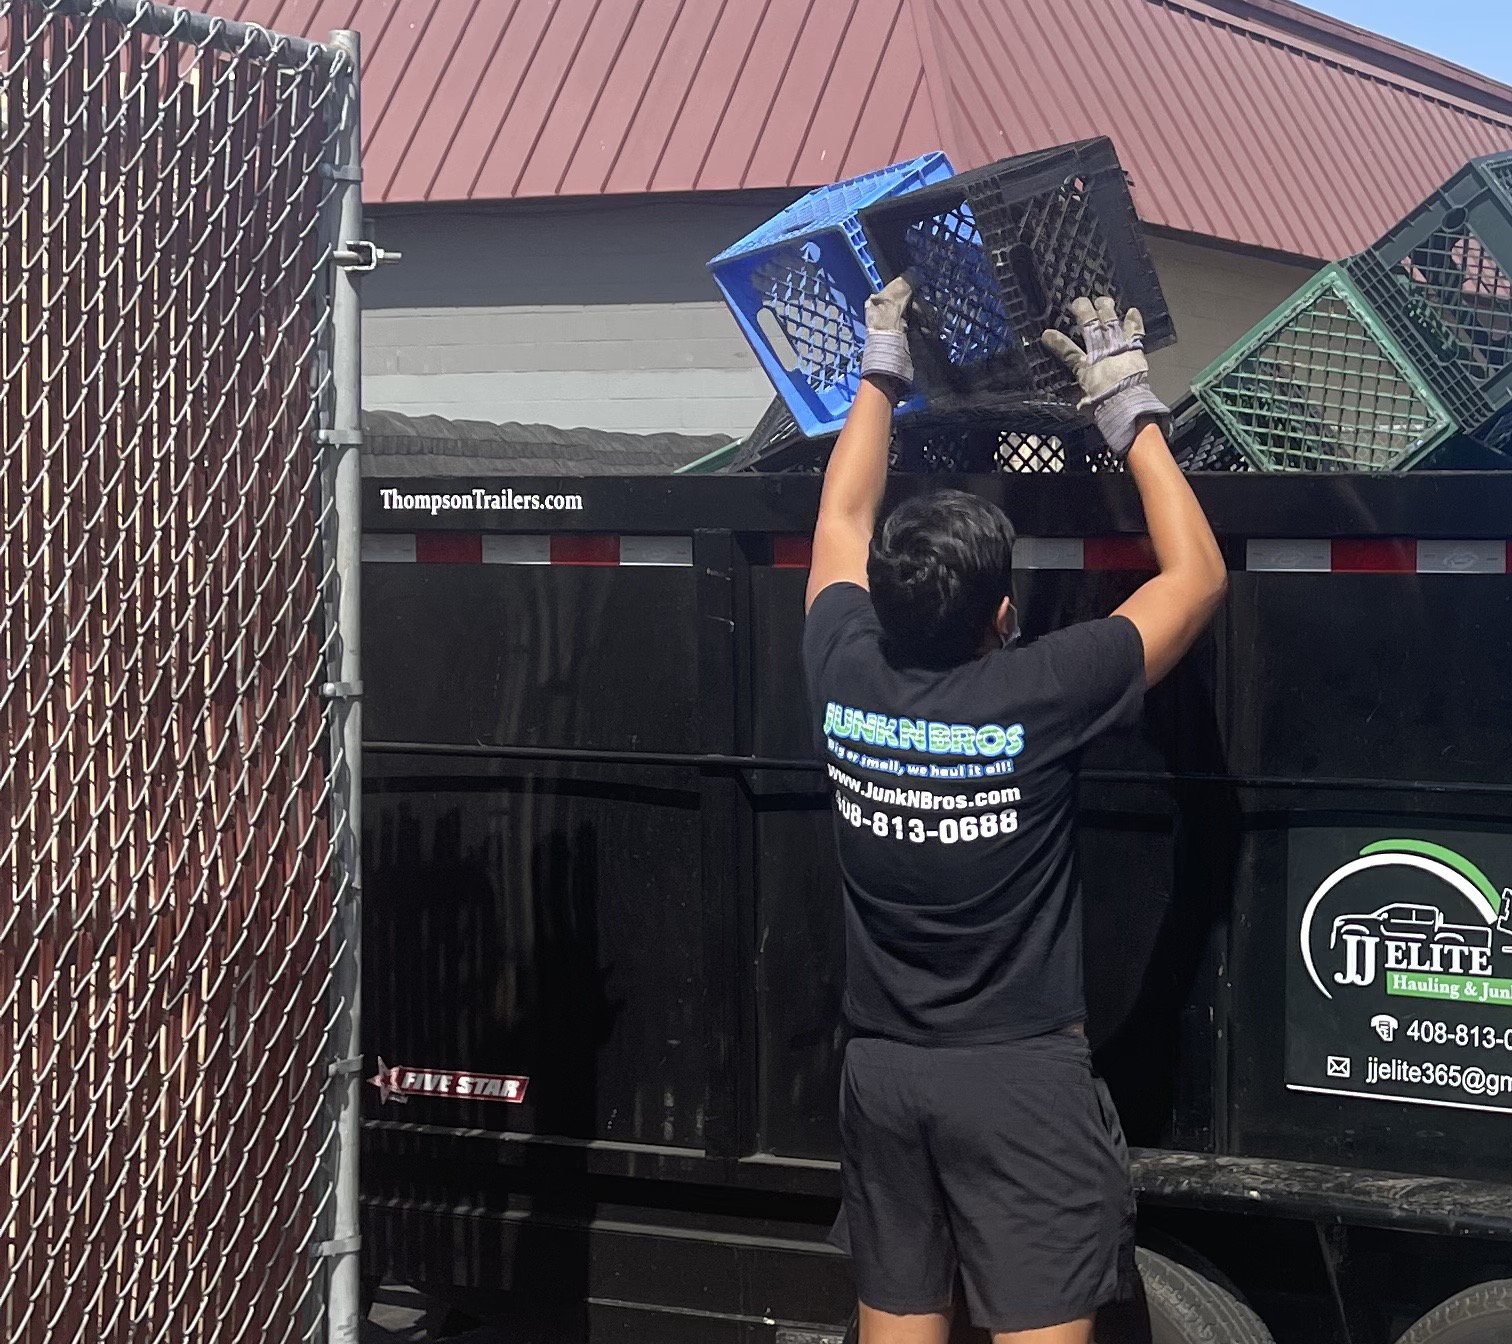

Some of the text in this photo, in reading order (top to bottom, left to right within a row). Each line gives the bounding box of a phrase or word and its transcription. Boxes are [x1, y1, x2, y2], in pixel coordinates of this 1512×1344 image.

[380, 488, 583, 515] ThompsonTrailers.com
[861, 754, 904, 776] small,
[907, 764, 928, 777] we
[929, 763, 966, 778] haul
[967, 763, 983, 777] it
[984, 757, 1014, 775] all!
[827, 763, 1021, 809] www.JunkNBros.com
[1384, 940, 1493, 976] ELITE
[1392, 974, 1459, 999] Hauling
[1464, 981, 1479, 996] &
[401, 1072, 520, 1098] FIVE STAR
